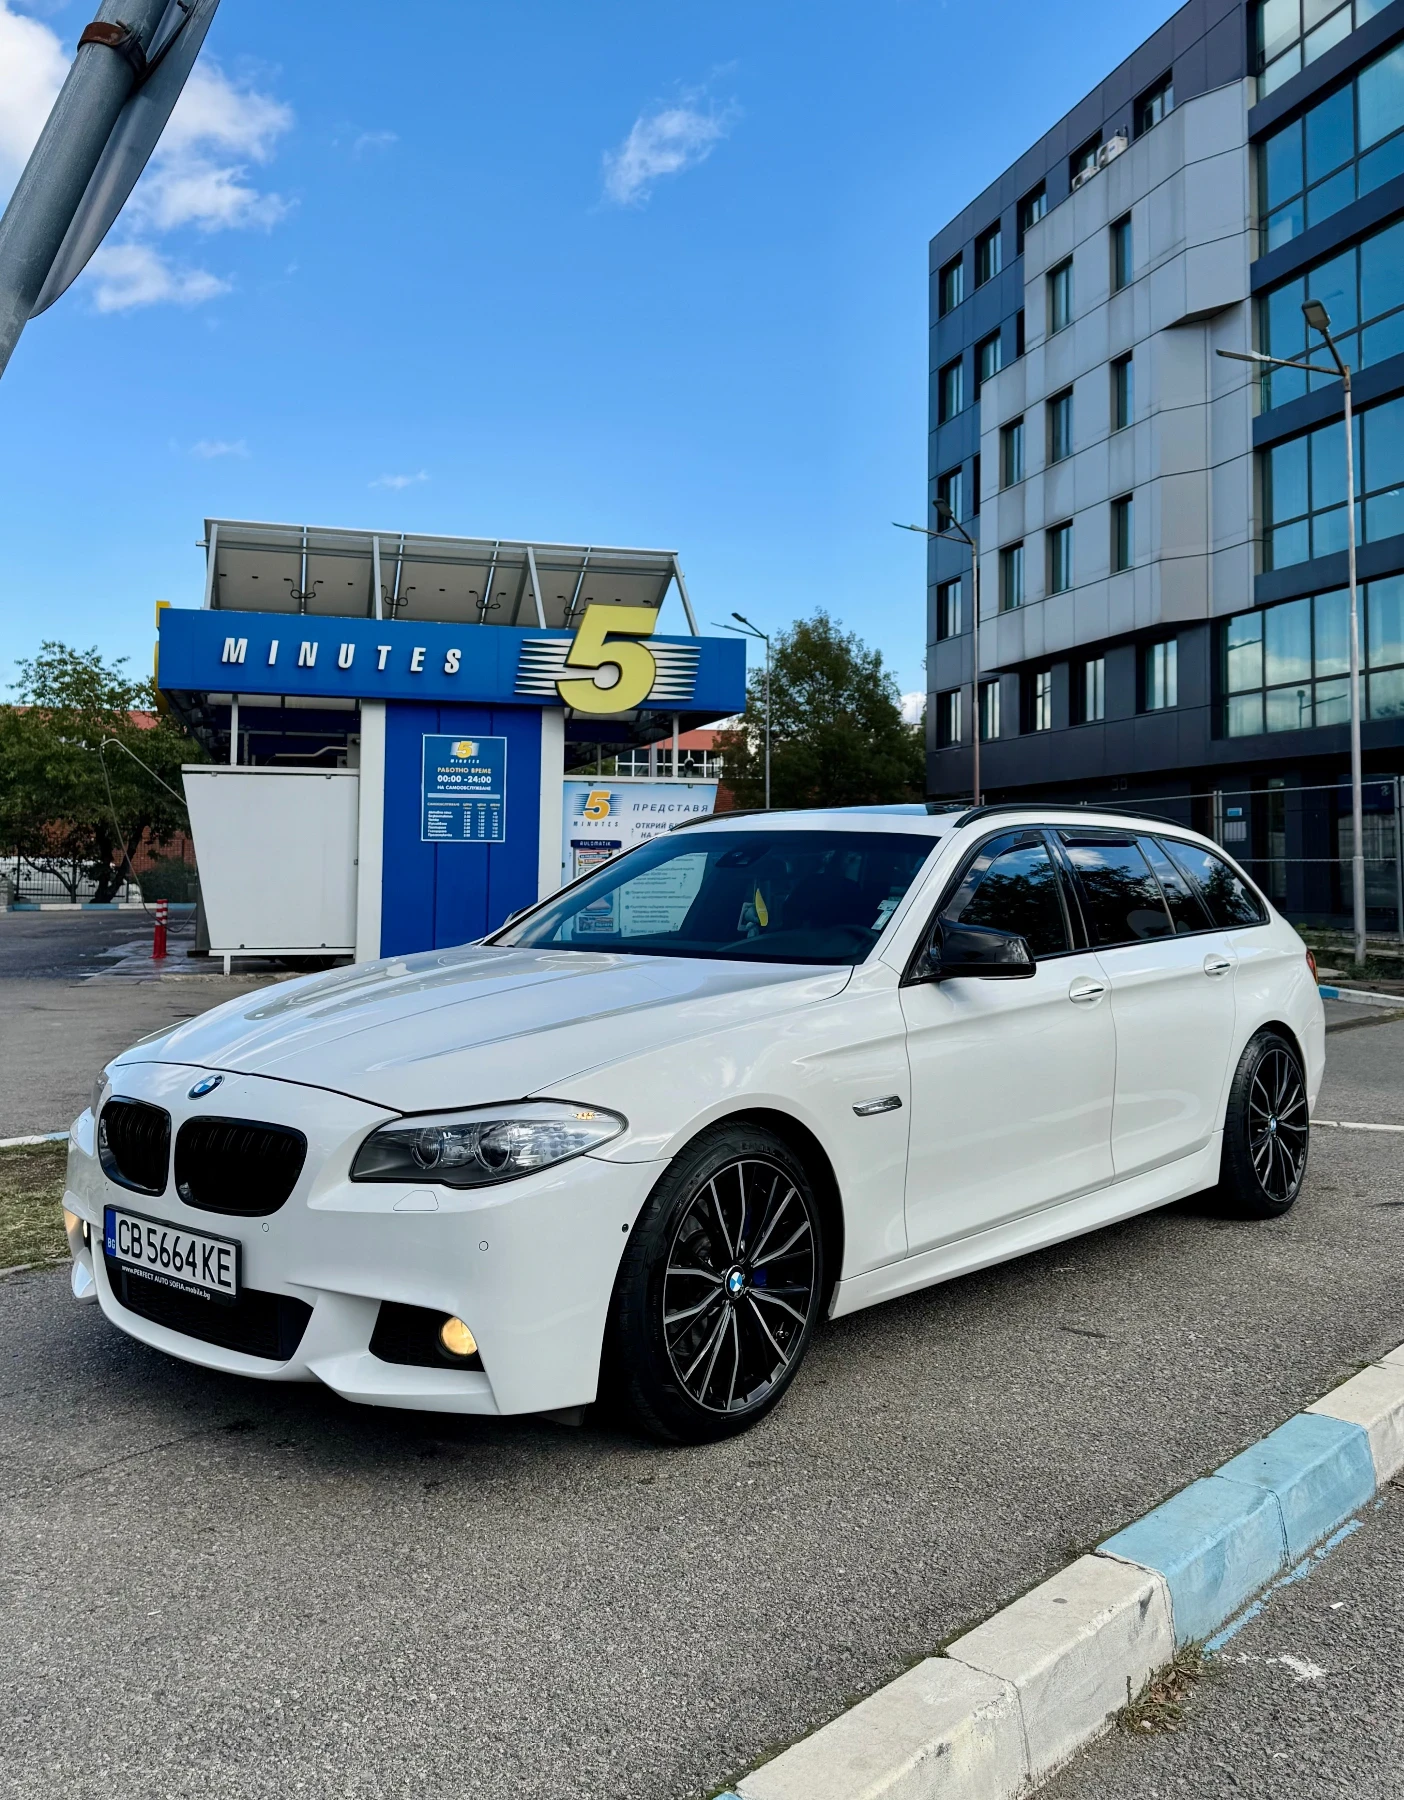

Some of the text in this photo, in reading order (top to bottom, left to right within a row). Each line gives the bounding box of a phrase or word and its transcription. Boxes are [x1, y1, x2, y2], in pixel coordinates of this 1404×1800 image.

[221, 636, 462, 674] MINUTES
[556, 604, 659, 714] 5
[457, 741, 473, 758] 5
[437, 775, 462, 783] 00:00
[583, 790, 612, 821] 5
[632, 803, 709, 813] ПРЕДСТАВЯ
[635, 821, 667, 829] ОТКРИЙ
[107, 1237, 116, 1250] BG
[154, 1275, 169, 1286] AUTO
